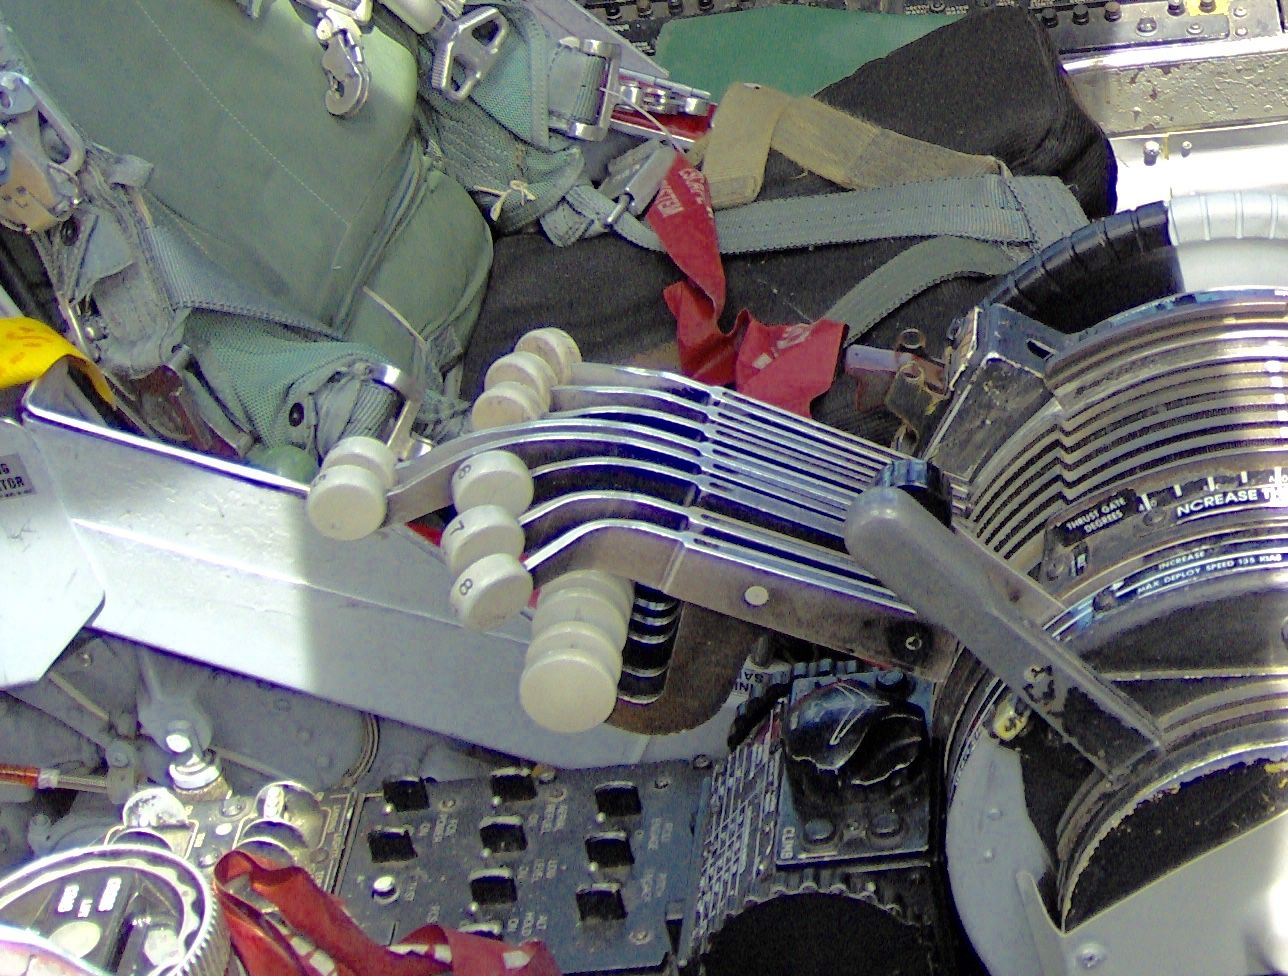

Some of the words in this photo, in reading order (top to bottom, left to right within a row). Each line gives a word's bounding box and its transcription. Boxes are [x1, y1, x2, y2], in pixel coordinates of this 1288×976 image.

[1065, 509, 1100, 530] THRUST
[1100, 497, 1127, 514] GATE
[1084, 509, 1124, 534] DEGREES
[1157, 551, 1206, 570] INCREASE
[1137, 580, 1160, 595] MAX
[1164, 567, 1202, 584] DEPLOY
[1205, 560, 1235, 572] SPEED
[780, 826, 796, 861] CLIMB
